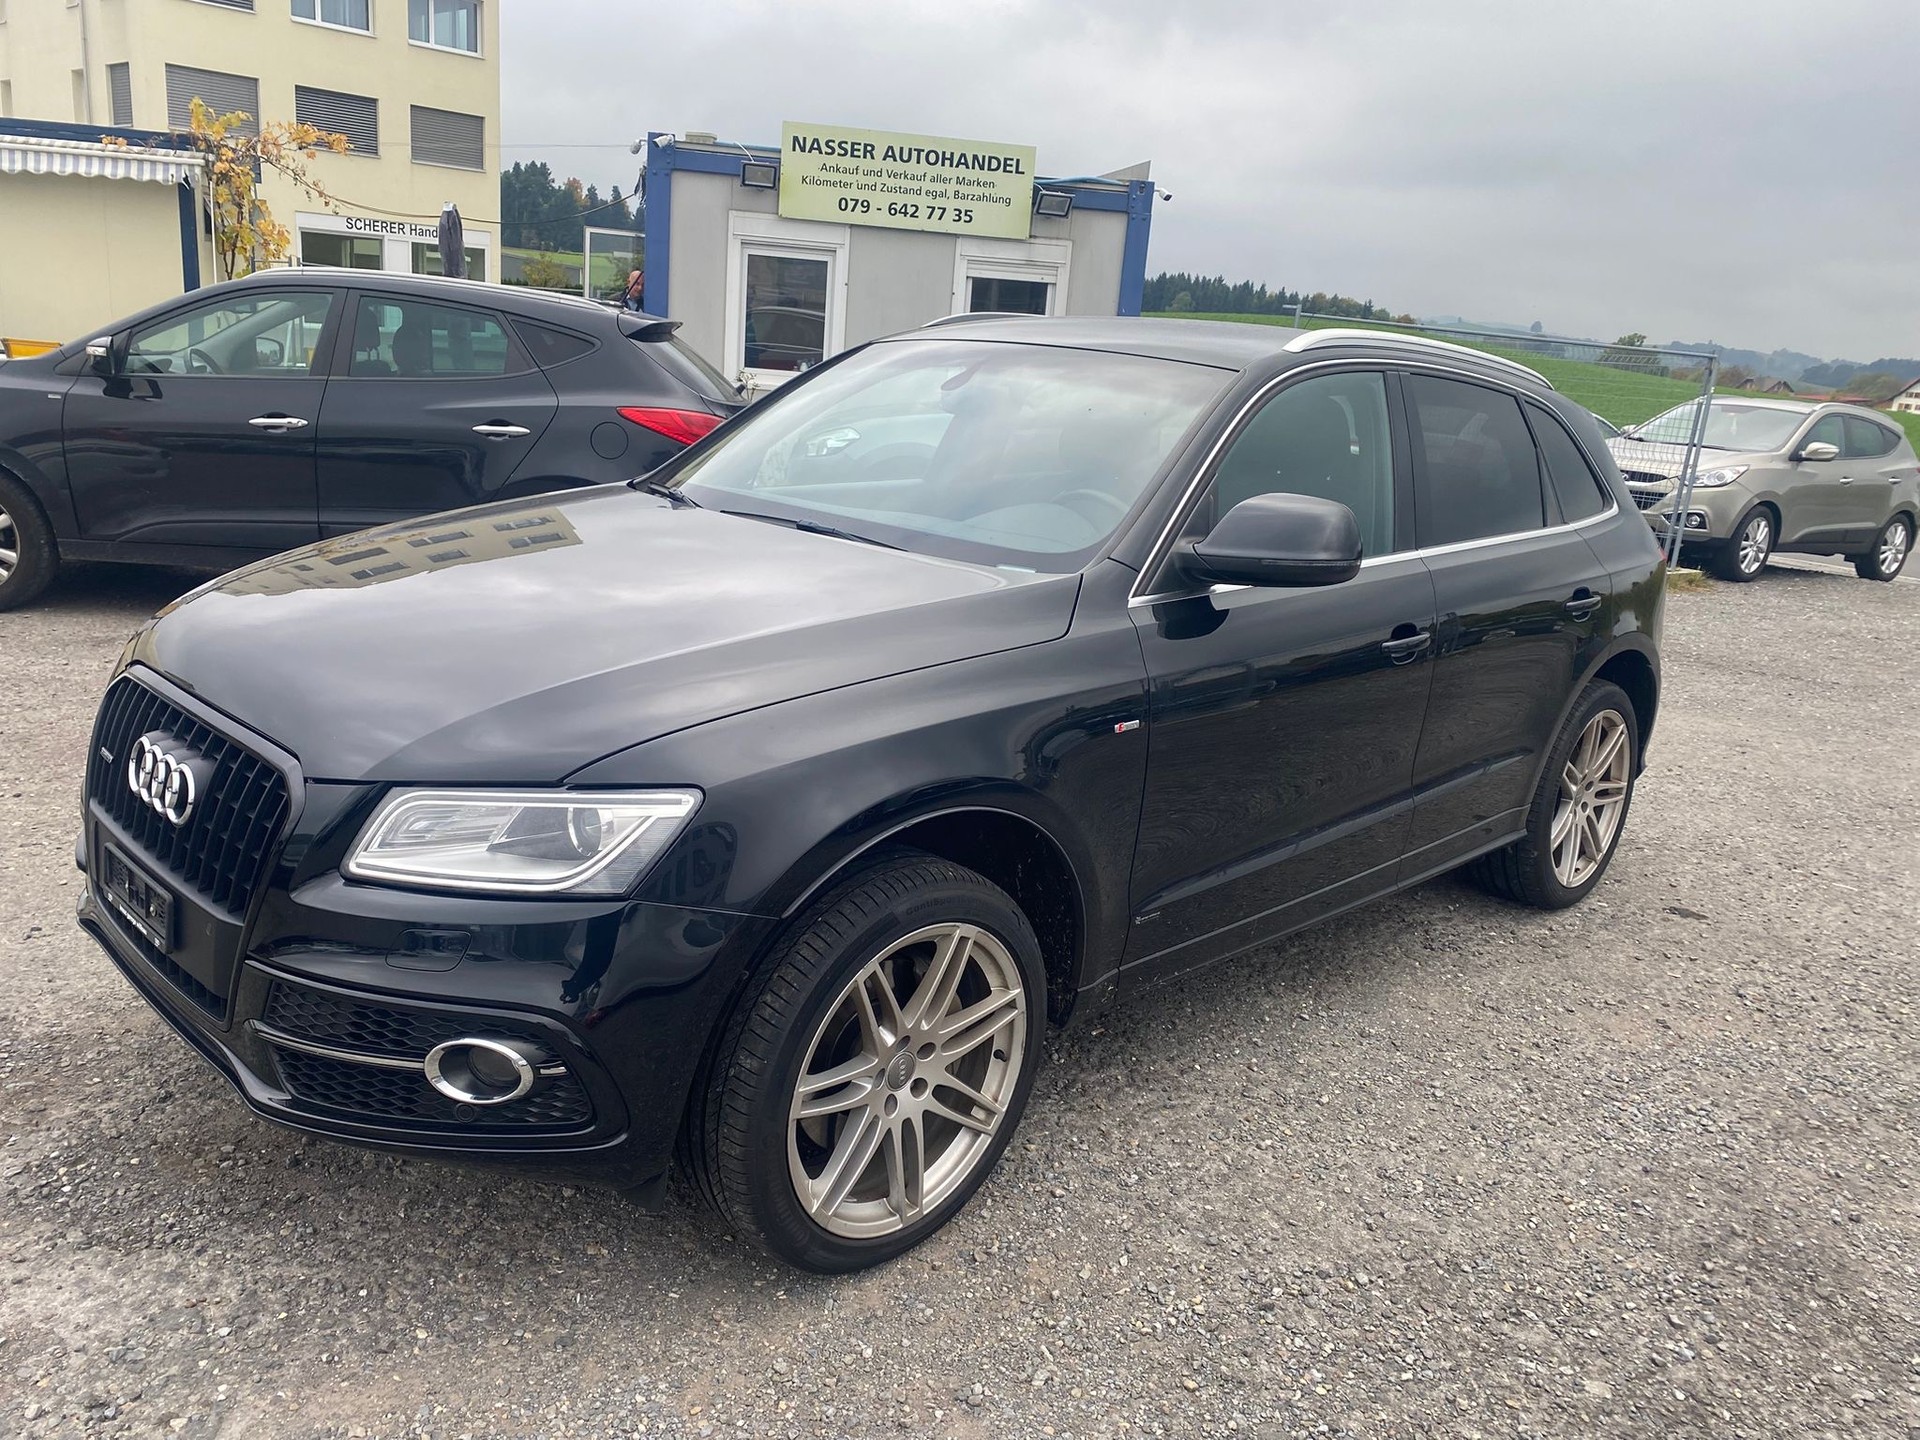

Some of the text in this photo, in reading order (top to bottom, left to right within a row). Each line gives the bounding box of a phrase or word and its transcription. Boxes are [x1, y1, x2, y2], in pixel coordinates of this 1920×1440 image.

[792, 135, 1025, 175] NASSER AUTOHANDEL
[820, 163, 995, 189] Ankauf und Verkauf aller Marken
[801, 175, 1012, 207] Kilometer und Zustand egal, Barzahlung
[838, 197, 870, 214] 079
[888, 202, 920, 218] 642
[926, 205, 947, 221] 77
[952, 208, 973, 223] 35
[345, 217, 438, 239] SCHERER Hand
